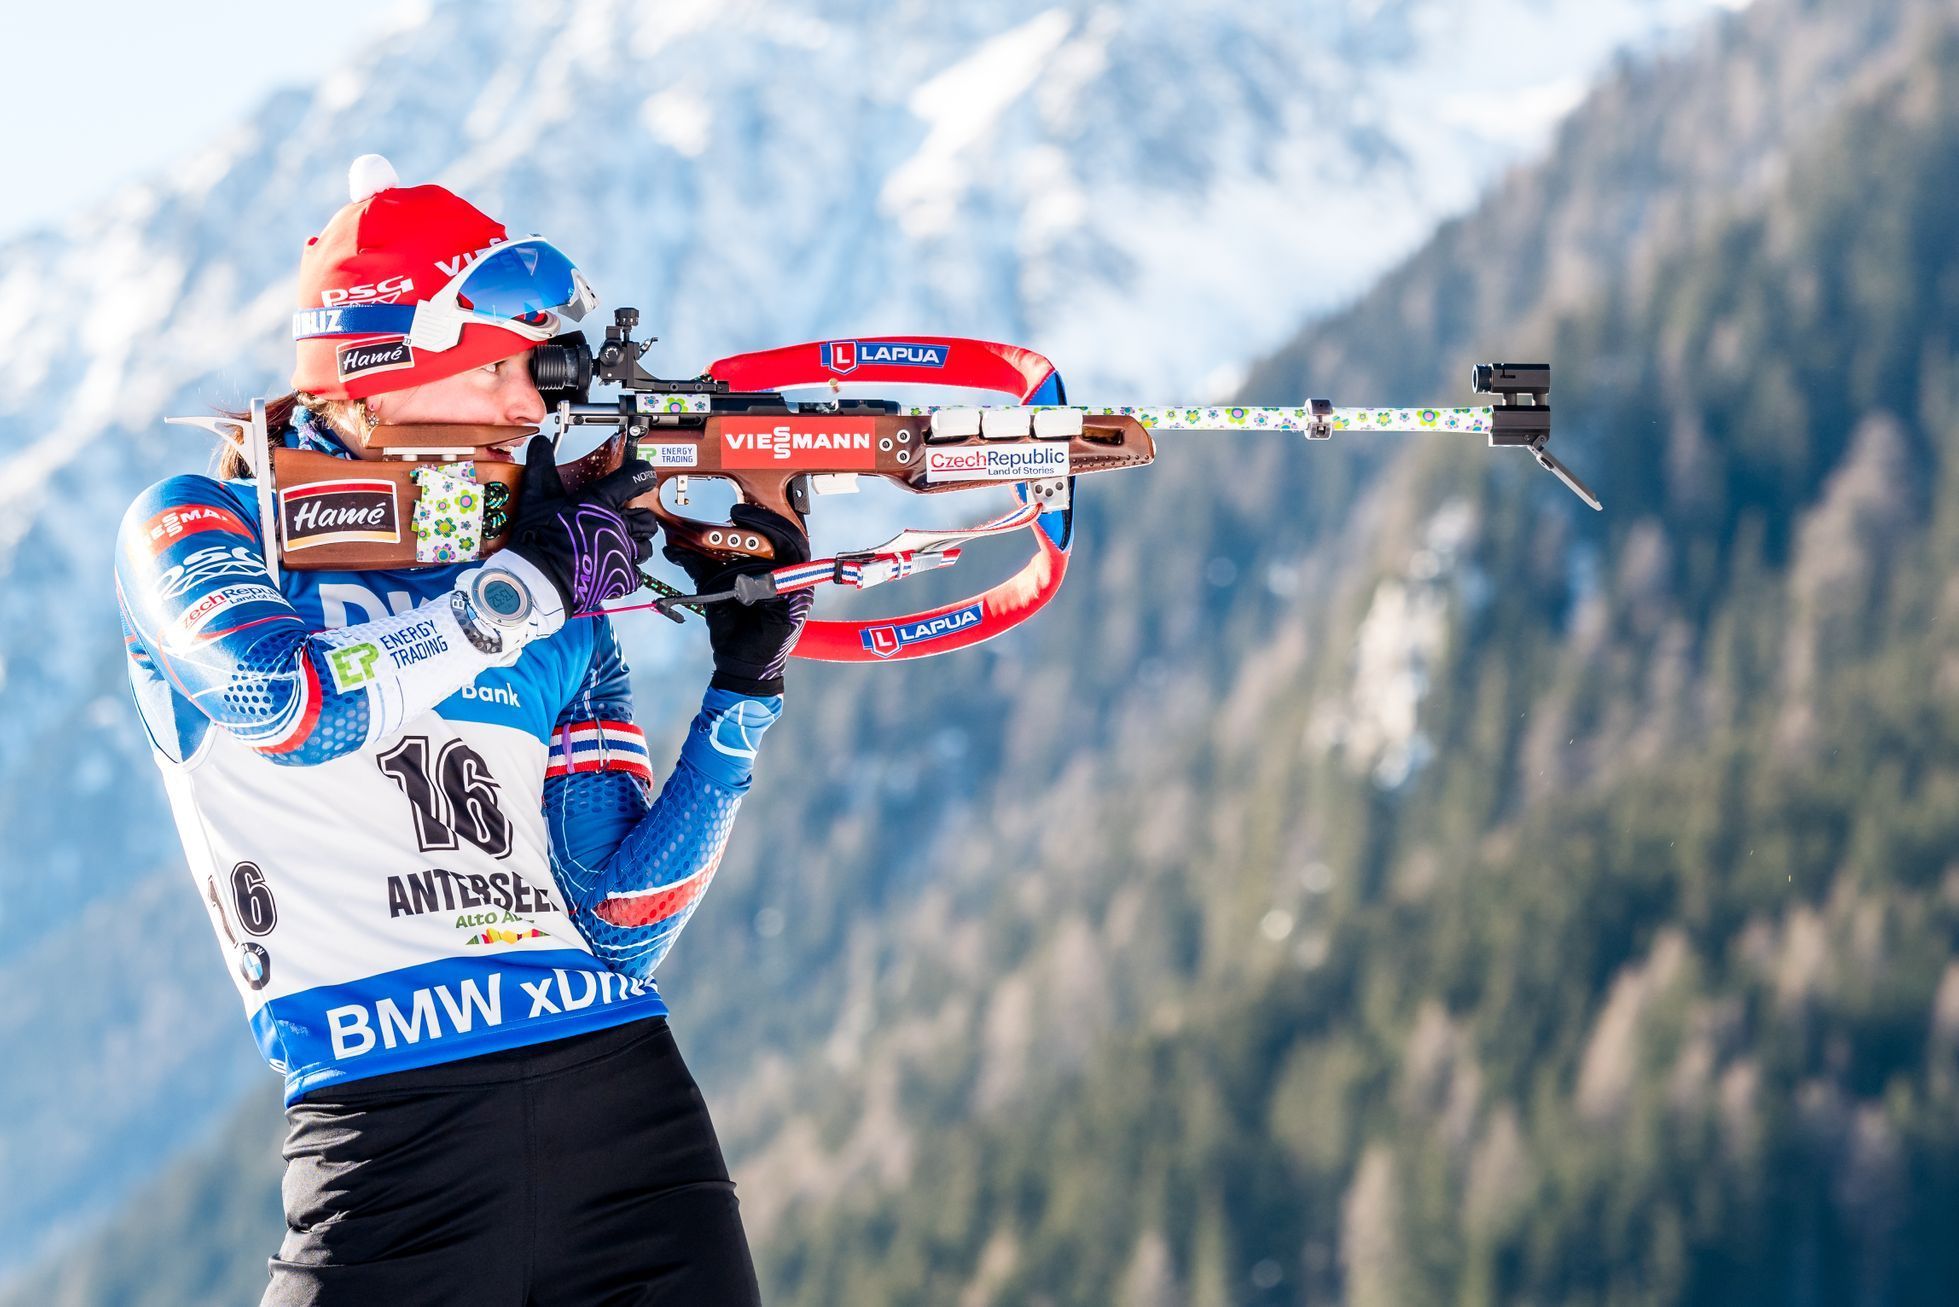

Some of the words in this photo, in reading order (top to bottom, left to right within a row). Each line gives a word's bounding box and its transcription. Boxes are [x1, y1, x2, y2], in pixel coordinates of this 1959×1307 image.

[343, 346, 403, 370] Hamé
[861, 346, 940, 364] LAPUA
[661, 447, 693, 455] ENERGY
[725, 426, 870, 459] VIESSMANN
[662, 455, 693, 463] TRADING
[988, 468, 1010, 476] Land
[1012, 466, 1021, 475] of
[1023, 465, 1055, 475] Stories
[294, 501, 386, 531] Hamé
[380, 619, 438, 650] ENERGY
[900, 611, 978, 640] LAPUA
[389, 634, 449, 670] TRADING
[461, 682, 521, 708] Bank
[376, 735, 513, 860] 16
[326, 972, 502, 1060] BMW
